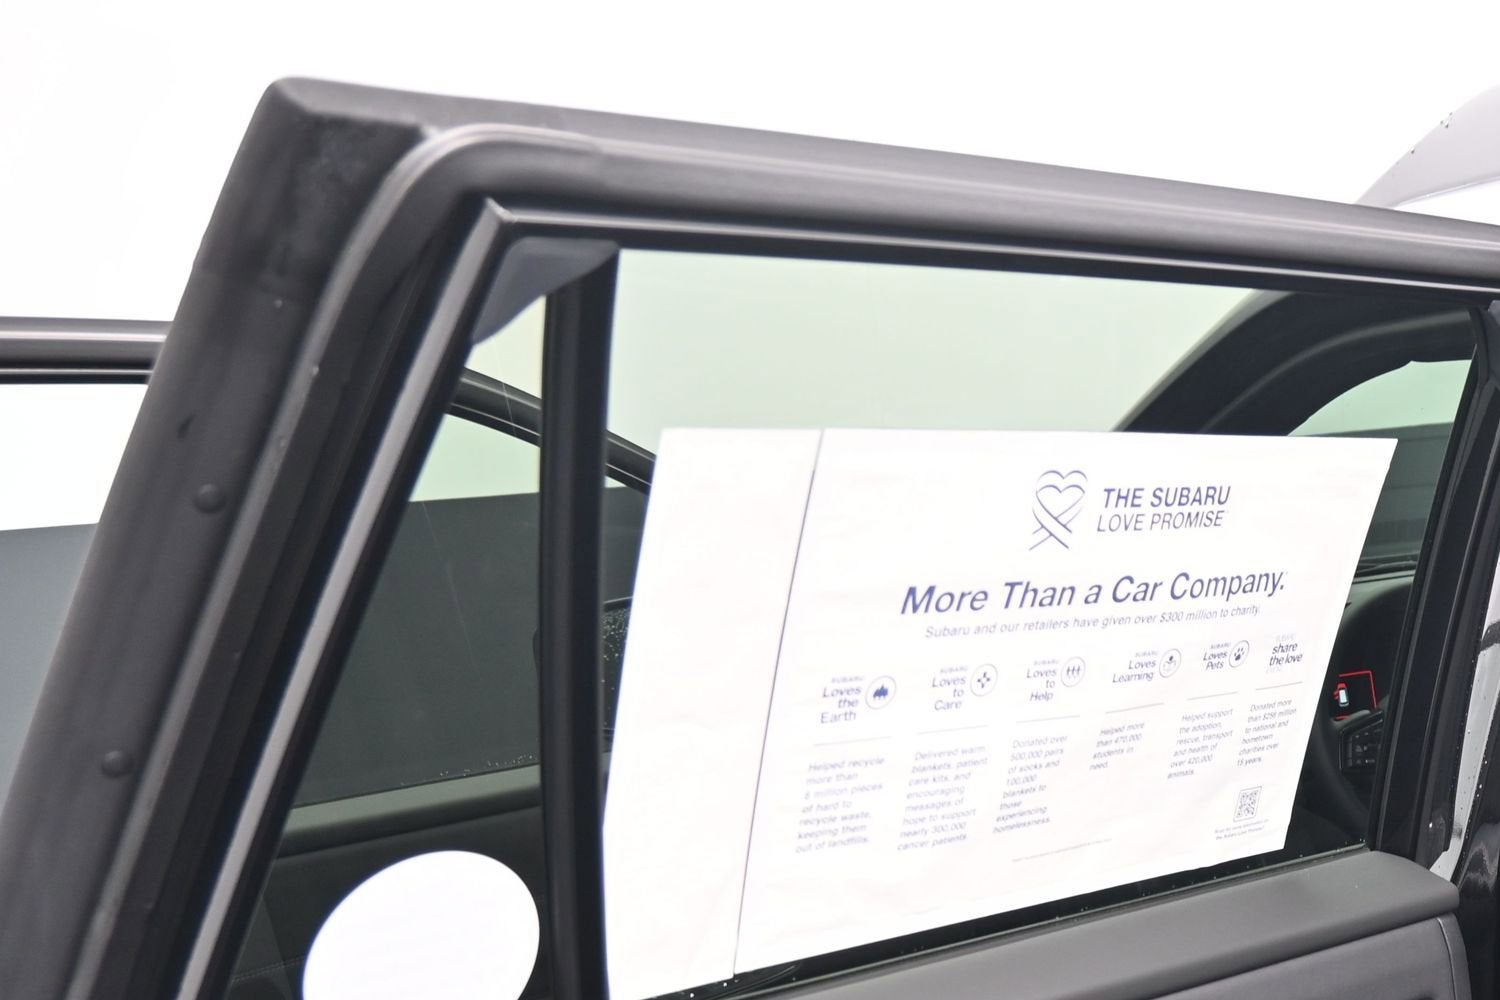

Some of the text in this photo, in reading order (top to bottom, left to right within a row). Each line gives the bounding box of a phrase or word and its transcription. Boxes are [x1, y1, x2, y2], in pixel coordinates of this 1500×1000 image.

[1103, 485, 1231, 508] THE SUBARU
[1097, 510, 1225, 532] LOVE PROMISE
[900, 585, 988, 615] More
[1000, 581, 1076, 609] Than
[1083, 583, 1102, 605] a
[1111, 575, 1164, 604] Car
[924, 624, 970, 639] Subaru
[974, 623, 996, 635] and
[999, 623, 1020, 633] our
[1023, 618, 1069, 631] retailers
[1073, 616, 1099, 628] have
[1101, 614, 1131, 629] given
[1134, 614, 1156, 625] over
[1185, 609, 1217, 622] million
[1220, 608, 1229, 619] to
[1272, 643, 1298, 655] share
[1203, 651, 1228, 661] Loves
[1269, 653, 1303, 666] the love
[1128, 660, 1156, 670] Loves
[1206, 661, 1225, 671] Pets
[1026, 668, 1057, 679] Loves
[1112, 671, 1154, 683] Learning
[932, 676, 967, 688] Loves
[1046, 679, 1056, 689] to
[822, 686, 863, 698] Loves
[953, 688, 964, 698] to
[1030, 691, 1054, 702] Help
[838, 698, 859, 709] the
[934, 700, 962, 711] Care
[821, 711, 856, 724] Earth
